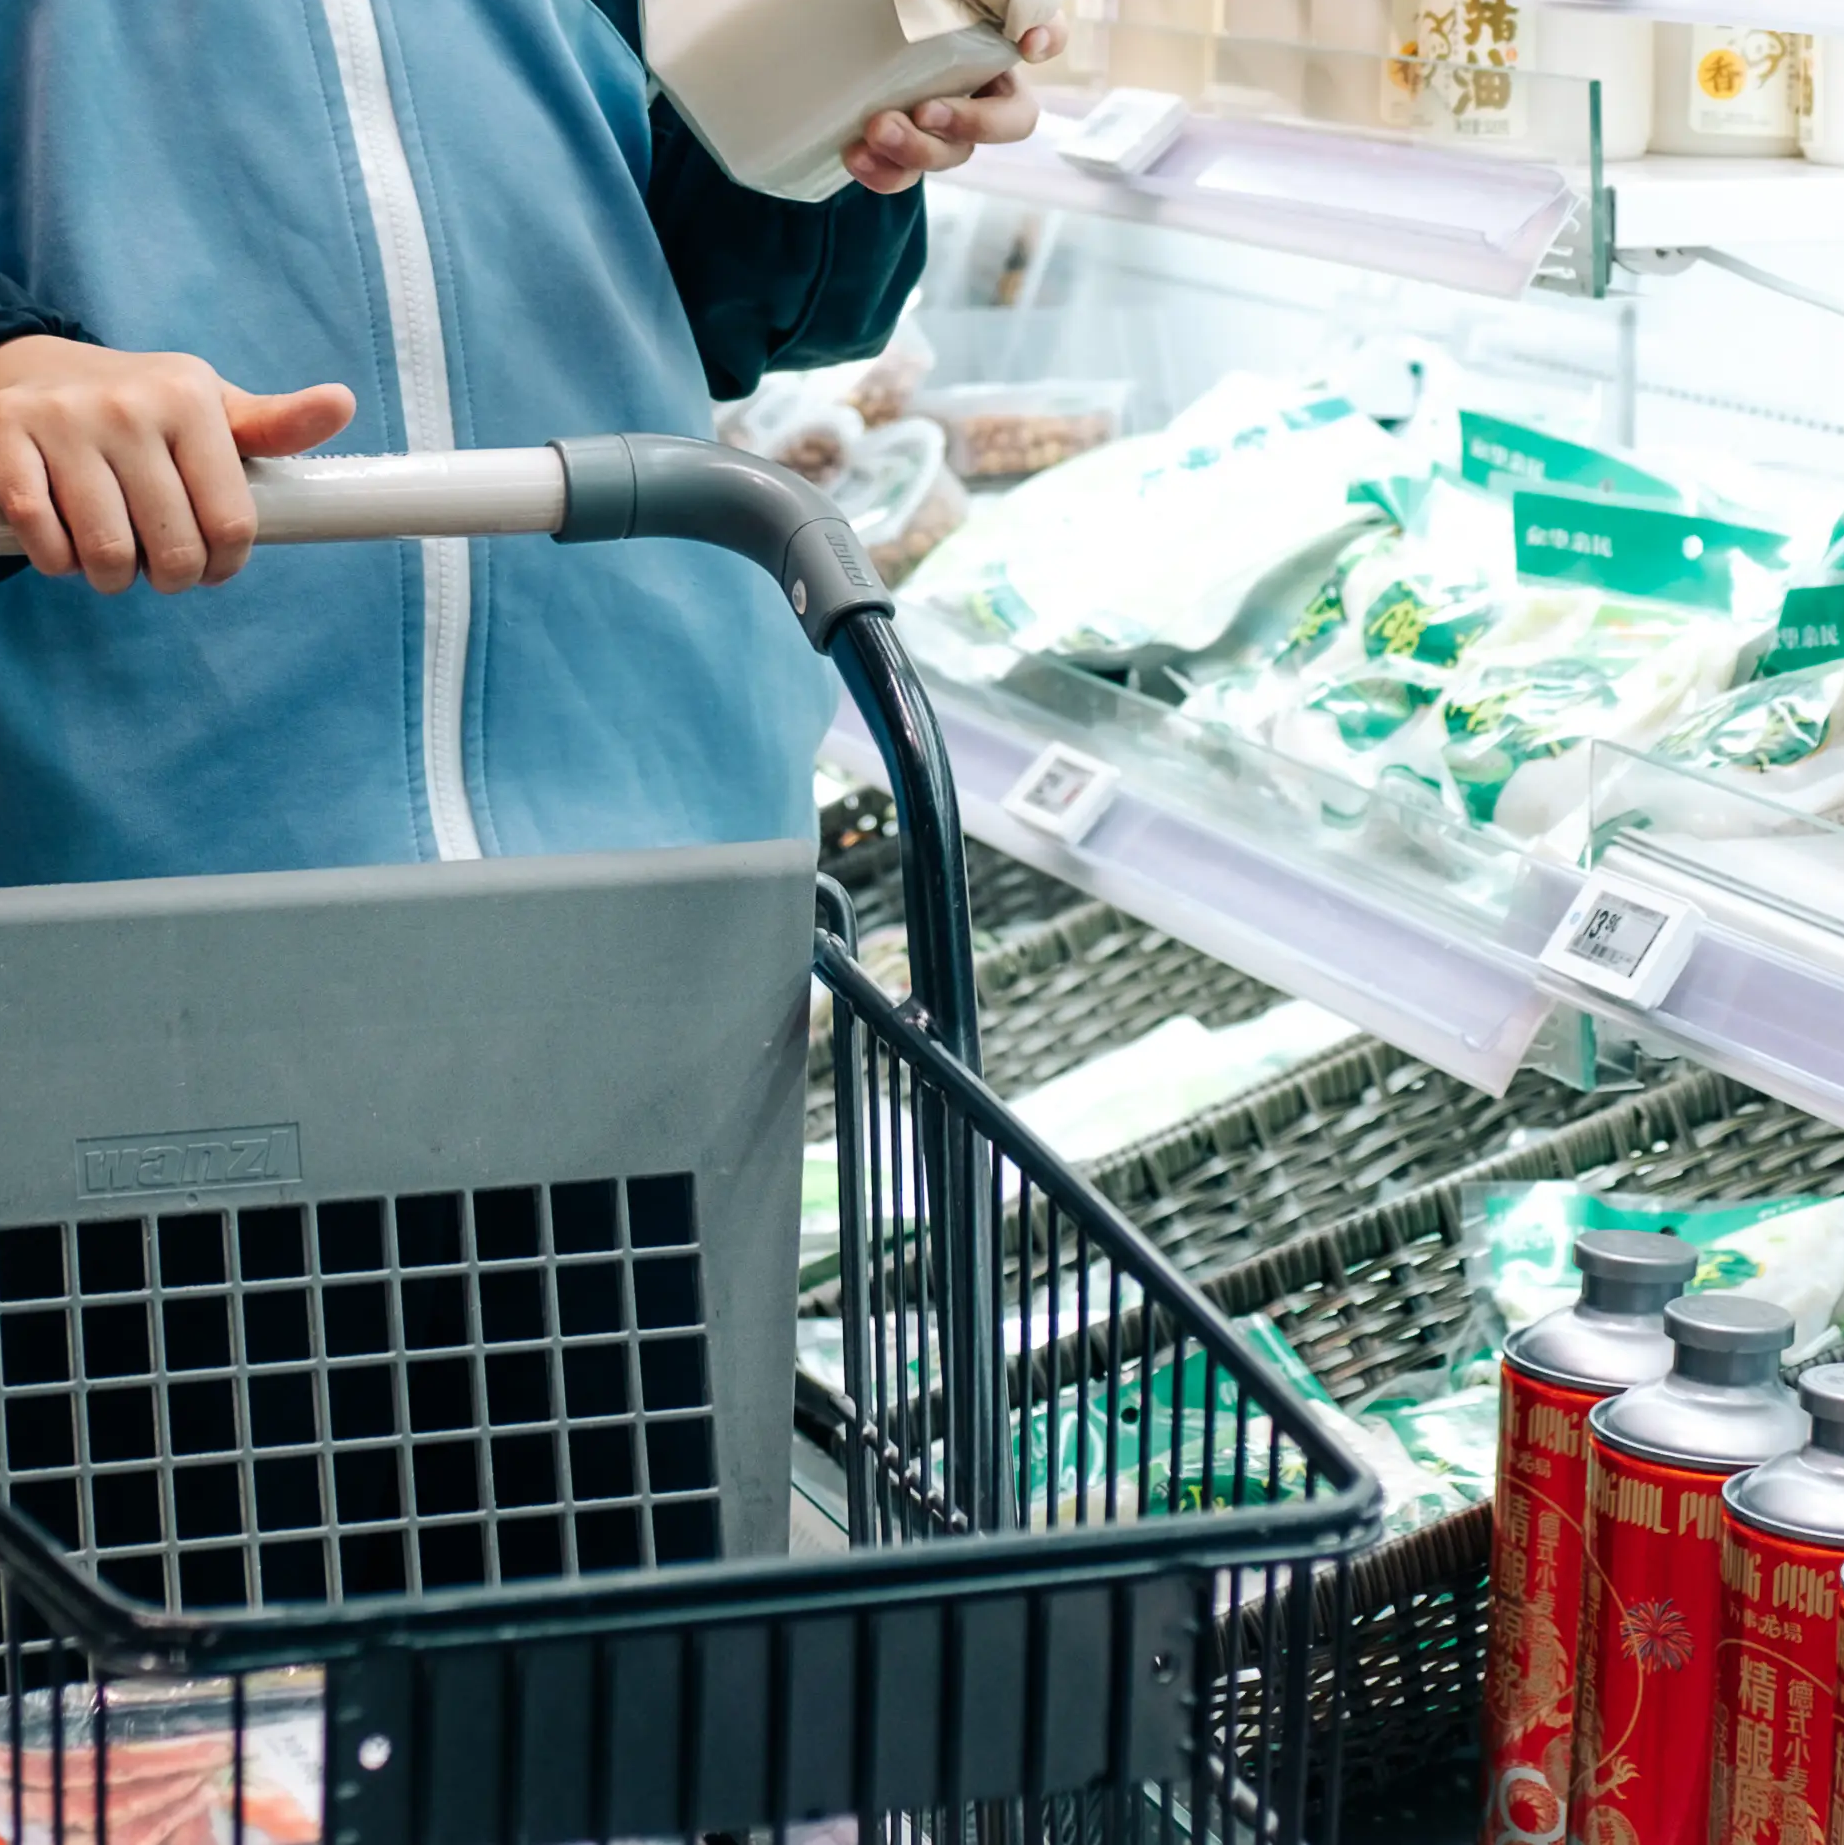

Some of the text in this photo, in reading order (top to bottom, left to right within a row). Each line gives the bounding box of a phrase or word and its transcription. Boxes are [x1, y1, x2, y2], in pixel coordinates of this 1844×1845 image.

[1706, 55, 1741, 94] 香
[86, 1130, 289, 1192] wanzl
[1732, 1655, 1778, 1845] 精酿原
